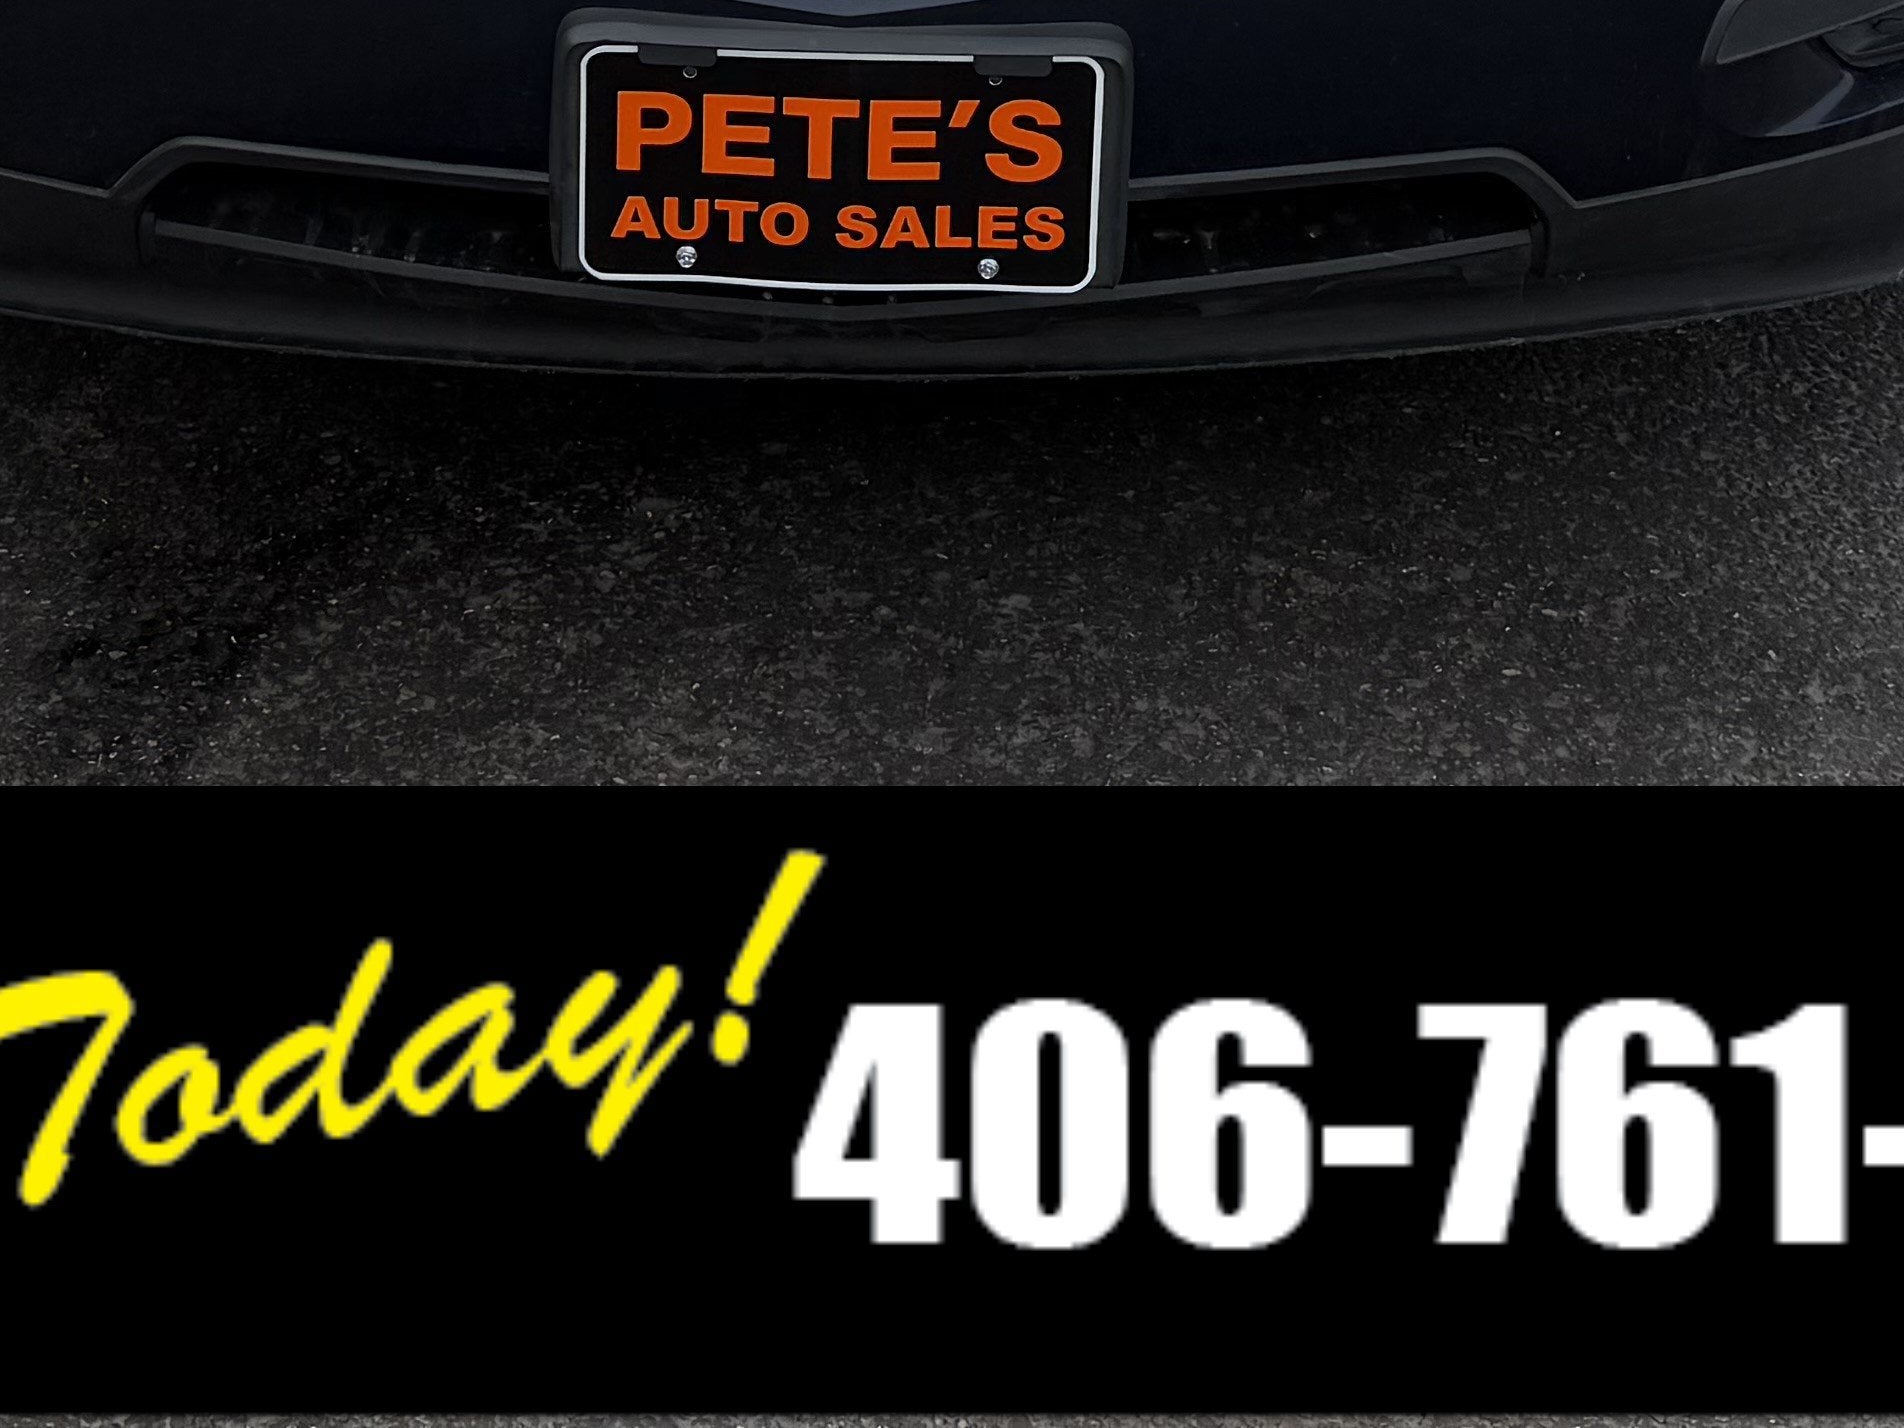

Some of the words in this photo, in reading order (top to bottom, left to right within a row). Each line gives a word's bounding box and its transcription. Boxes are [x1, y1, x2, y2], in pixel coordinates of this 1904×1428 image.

[616, 90, 1064, 184] PETE'S
[610, 195, 810, 247] AUTO
[834, 204, 1066, 252] SALES
